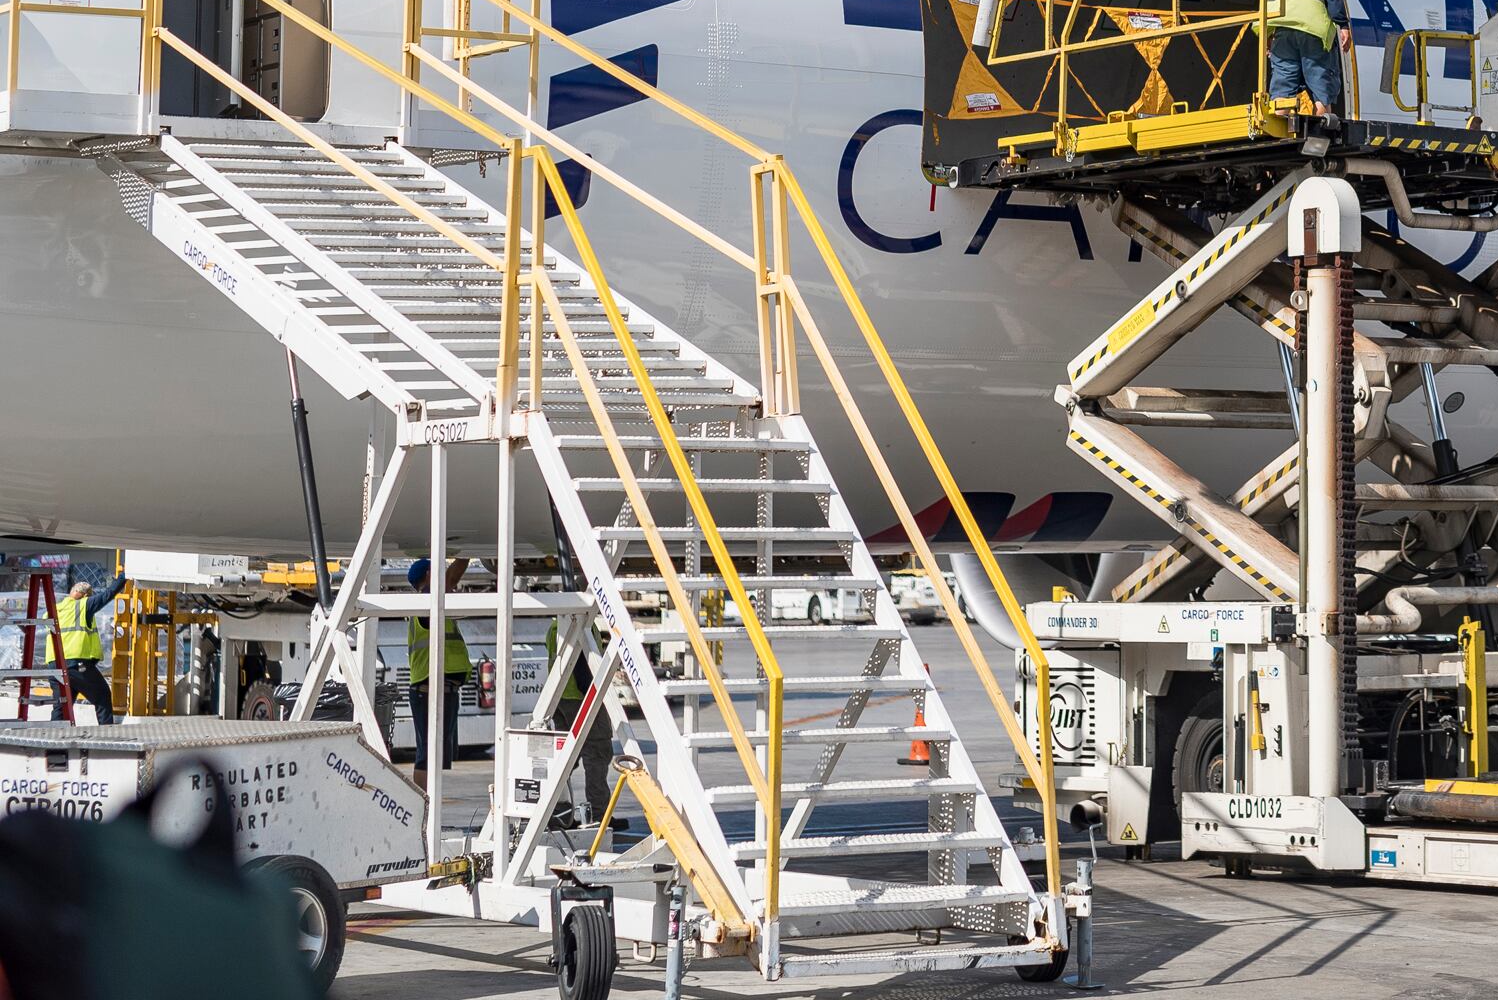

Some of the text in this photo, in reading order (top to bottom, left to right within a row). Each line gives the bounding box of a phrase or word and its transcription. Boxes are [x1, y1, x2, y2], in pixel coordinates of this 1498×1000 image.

[184, 240, 237, 295] CARGO FORCE
[425, 421, 468, 444] CCS1027
[1048, 617, 1087, 628] COMMANDER
[1182, 609, 1244, 620] CARGO FORCE
[592, 576, 643, 695] CARGO FORCE
[1055, 709, 1086, 728] JBT
[1, 779, 109, 798] CARGO FORCE
[205, 786, 285, 812] GRBAGE
[326, 752, 412, 827] CARGO FORCE
[1229, 797, 1282, 819] CLD1032
[236, 812, 269, 833] ART
[366, 856, 425, 877] prowler
